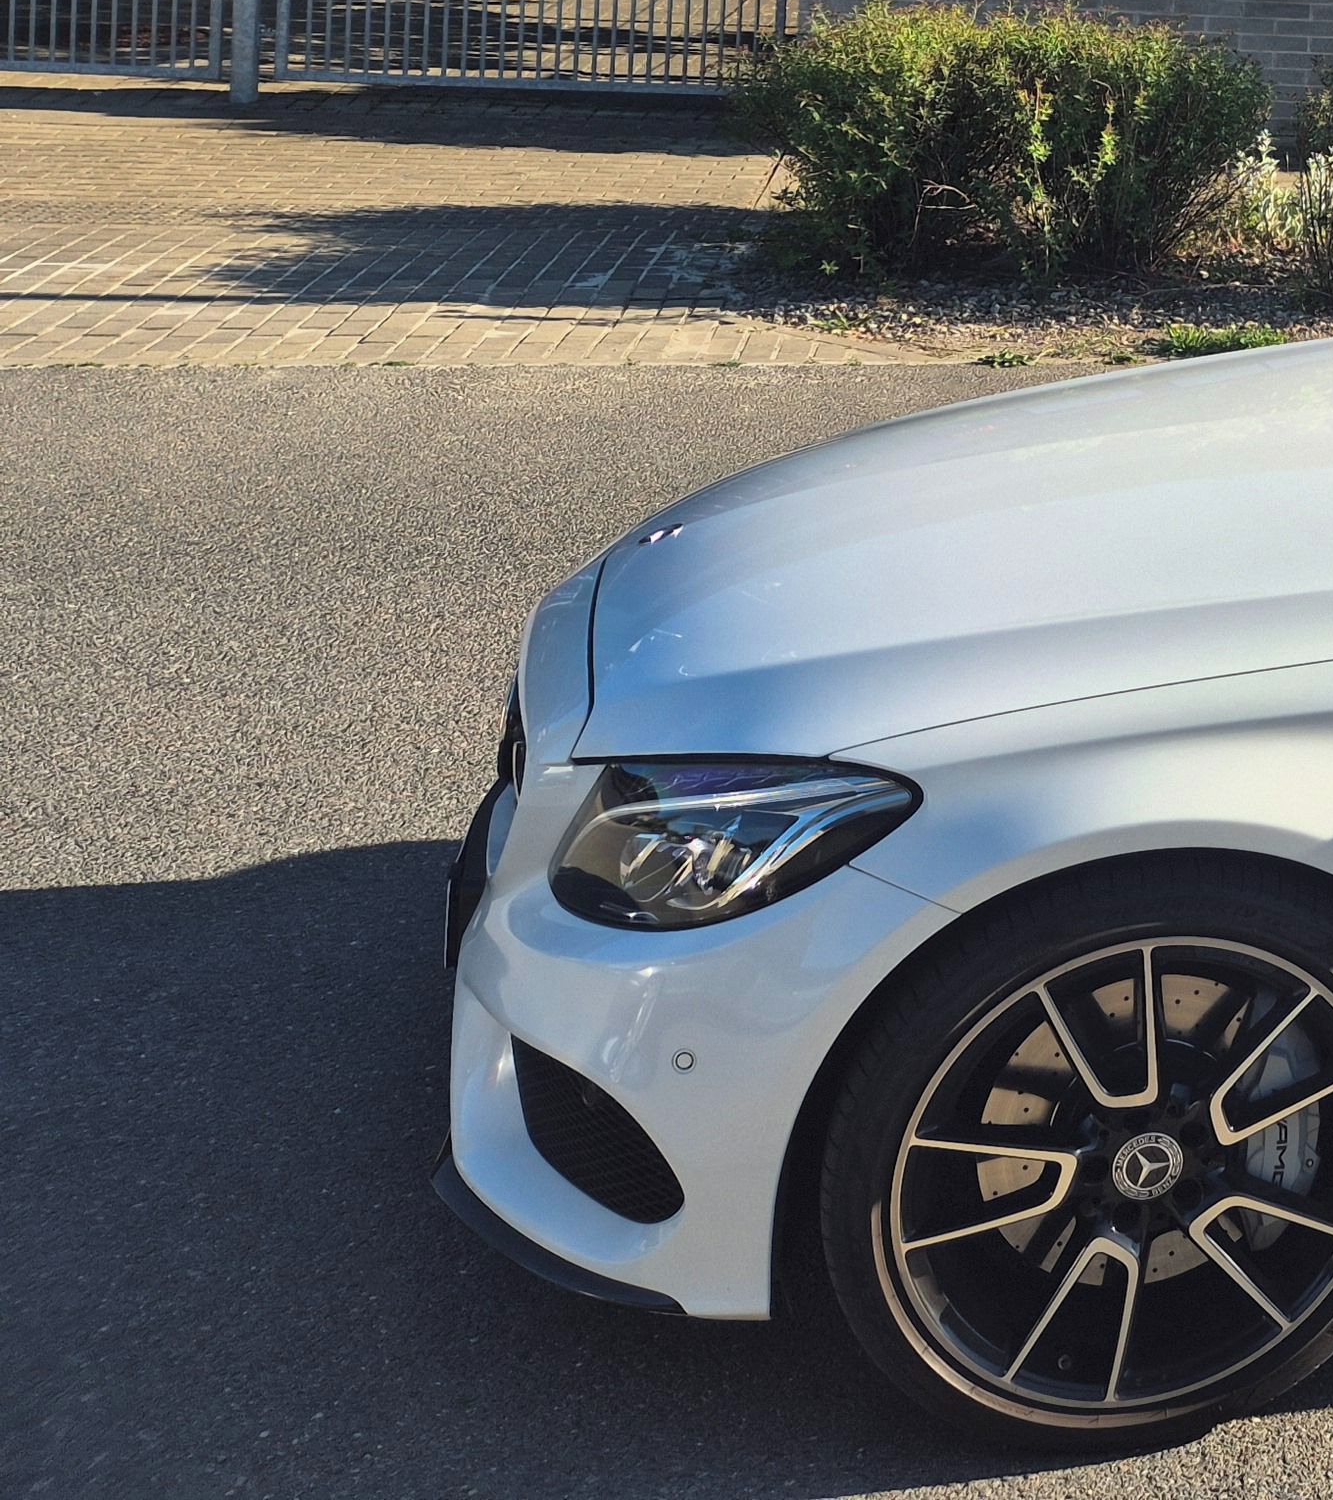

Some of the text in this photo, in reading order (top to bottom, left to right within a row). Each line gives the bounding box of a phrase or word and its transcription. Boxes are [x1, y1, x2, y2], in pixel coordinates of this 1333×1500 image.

[1116, 1135, 1156, 1167] MERCEDES
[1271, 1122, 1288, 1188] AMG
[1151, 1176, 1174, 1197] BENZ
